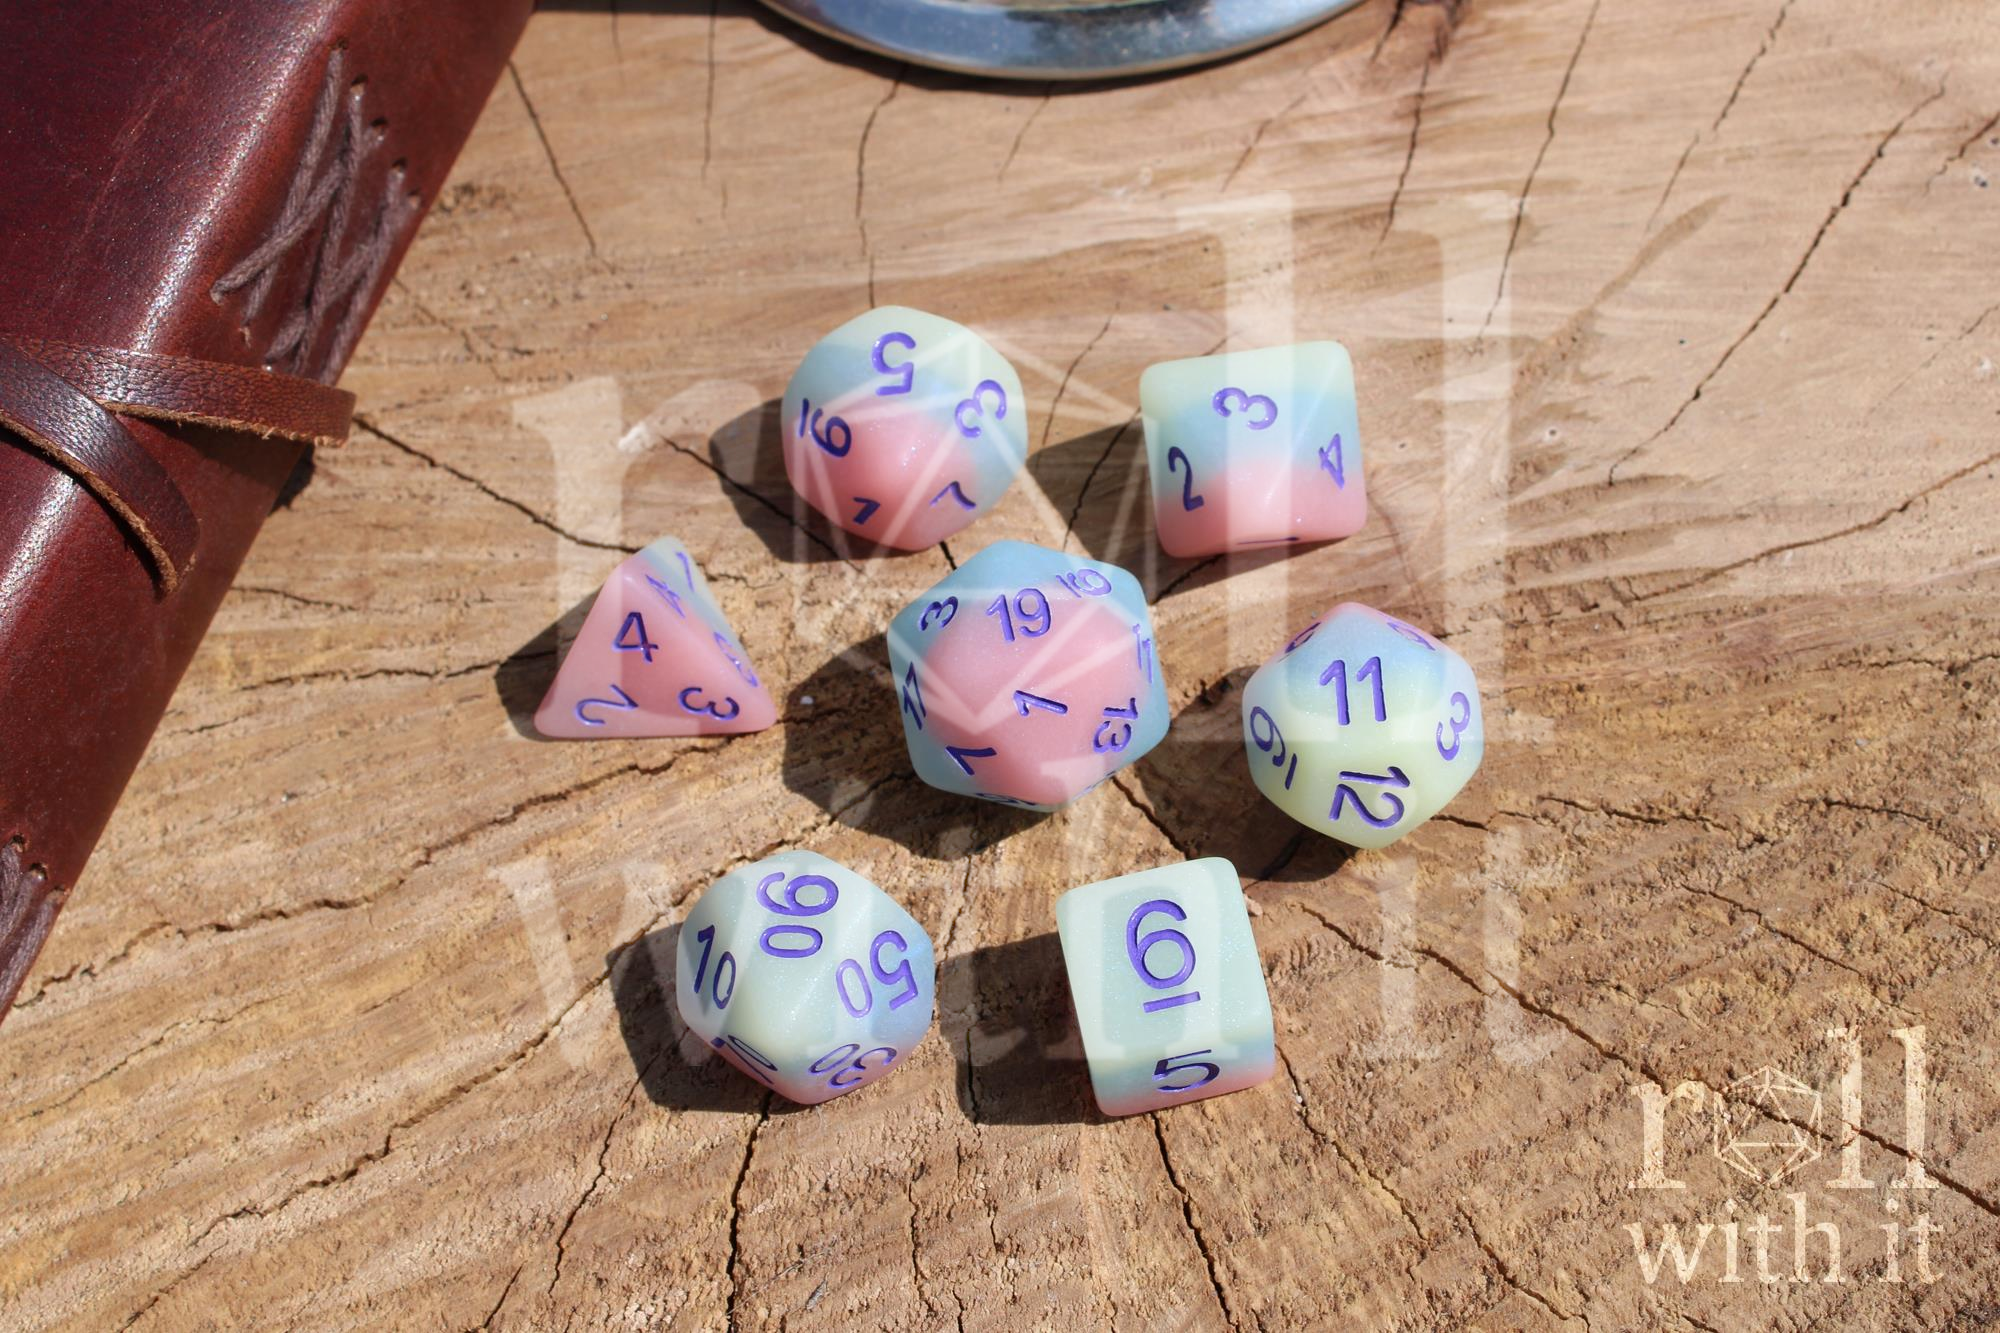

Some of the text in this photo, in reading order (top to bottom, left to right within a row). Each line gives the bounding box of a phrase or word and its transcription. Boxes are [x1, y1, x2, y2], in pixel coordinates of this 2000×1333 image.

[871, 331, 916, 396] 5
[954, 379, 1007, 438] 3
[1212, 387, 1278, 430] 3
[1168, 446, 1204, 512] 2
[1319, 433, 1345, 490] 4
[613, 612, 659, 662] 4
[916, 596, 958, 631] 3
[985, 588, 1051, 642] 19
[573, 683, 639, 726] 2
[678, 687, 740, 720] 3
[1013, 689, 1068, 717] 1
[1319, 656, 1387, 725] 11
[1093, 697, 1139, 754] 13
[1436, 691, 1471, 761] 3
[1328, 765, 1411, 829] 12
[756, 871, 840, 959] 90
[693, 924, 737, 1010] 10
[835, 930, 919, 1019] 50
[1125, 899, 1202, 1014] 6
[808, 1043, 898, 1089] 30
[1152, 1049, 1221, 1093] 5
